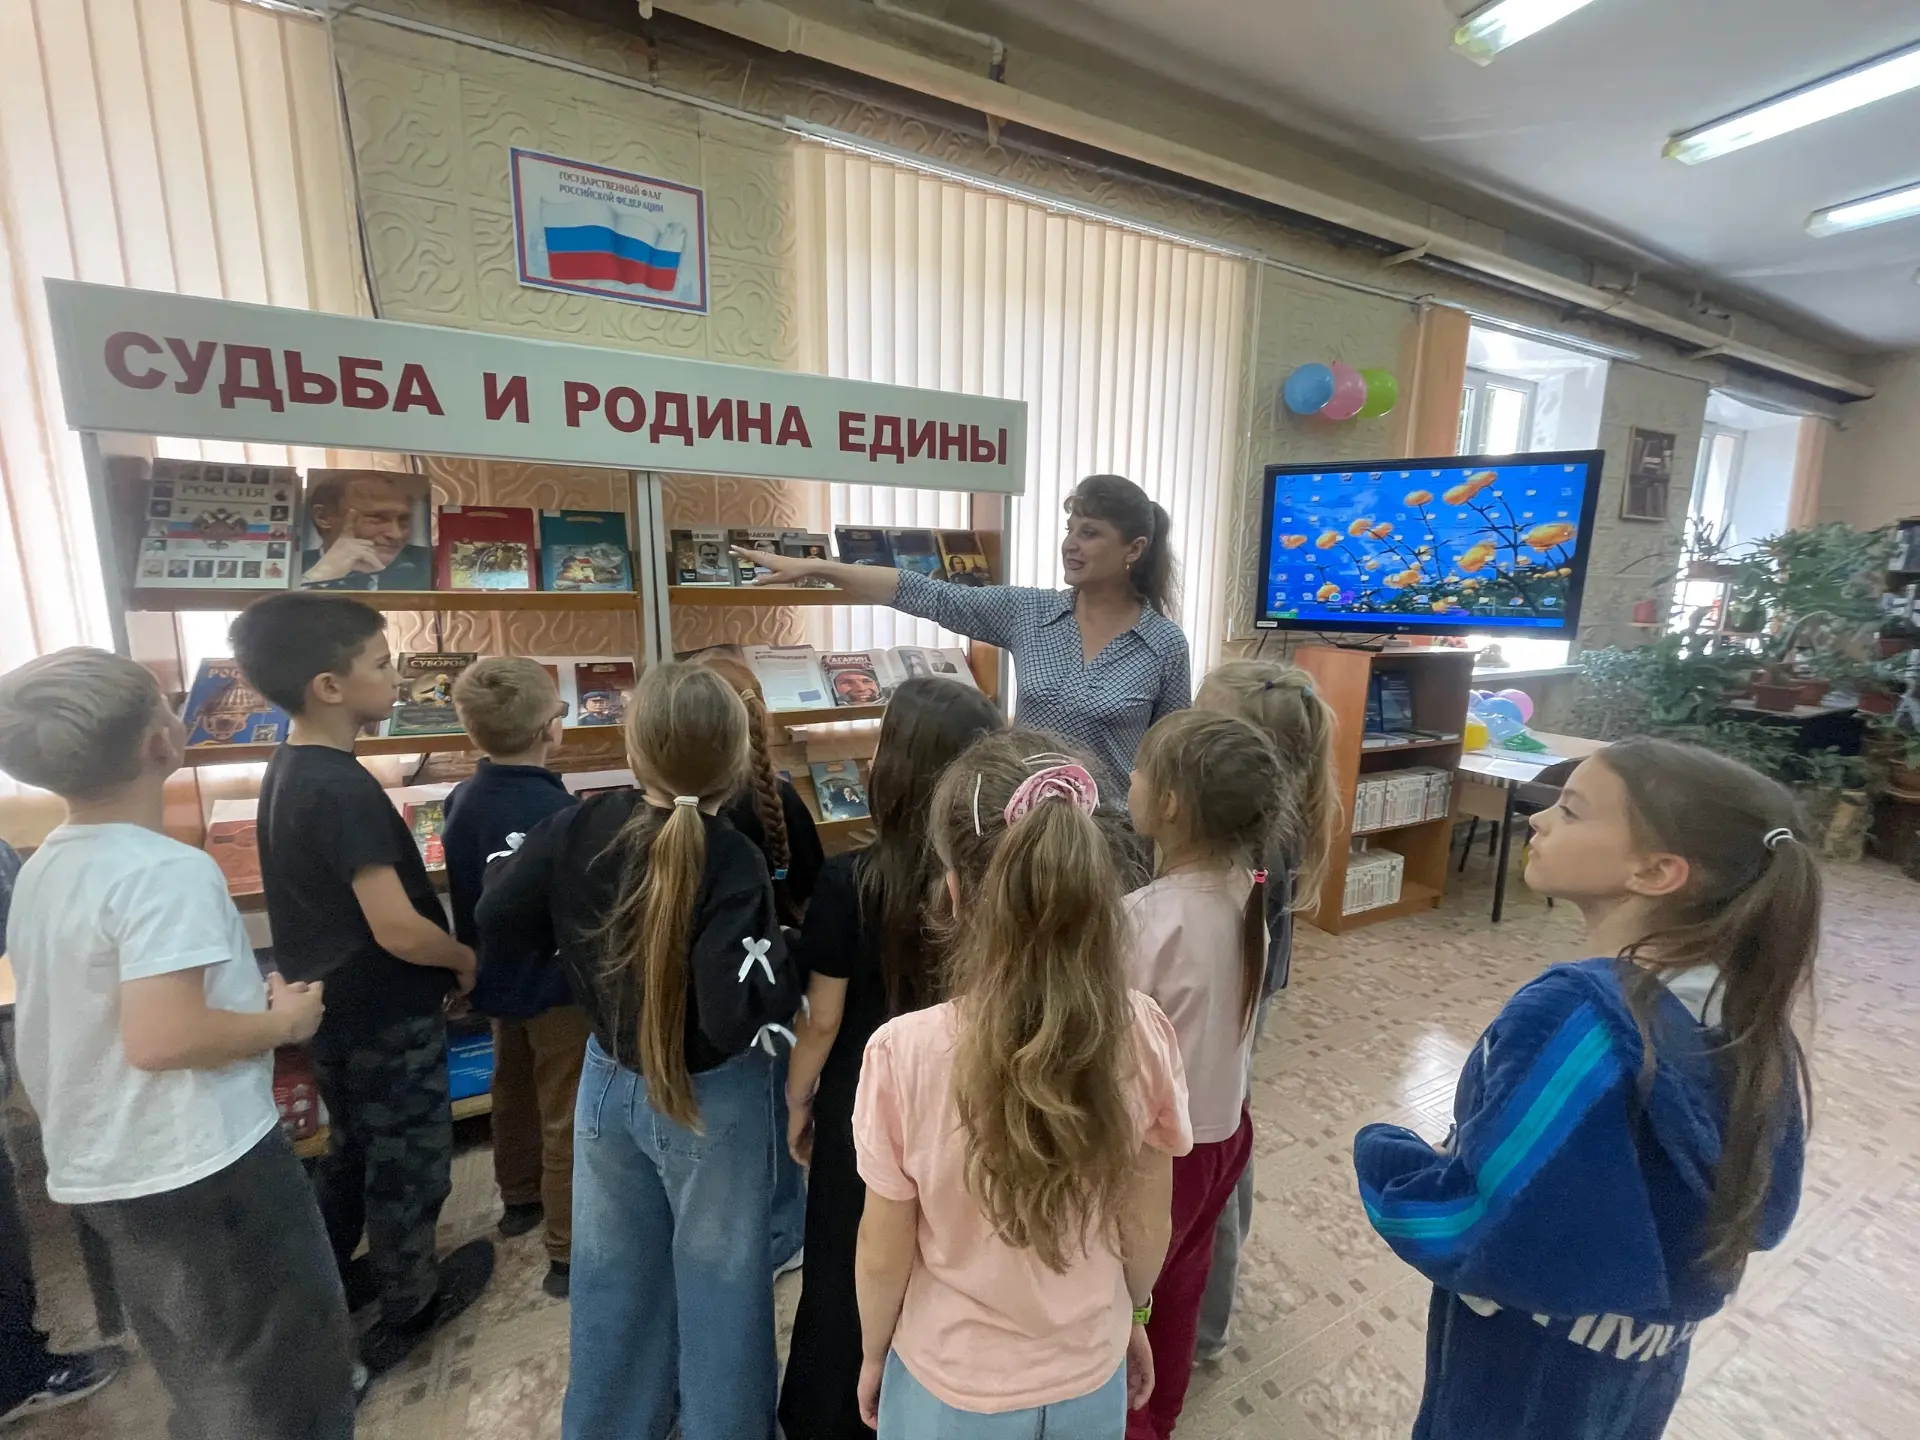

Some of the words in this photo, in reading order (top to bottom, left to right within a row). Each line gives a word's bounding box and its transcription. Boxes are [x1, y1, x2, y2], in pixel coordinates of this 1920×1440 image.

[559, 171, 640, 196] ГОСУДАРСТВЕННЫЙ
[641, 188, 663, 201] ФЛАГ
[559, 184, 615, 204] РОССИЙСКОЙ
[616, 196, 664, 213] ФЕДЕРАЦИИ
[103, 330, 443, 416] СУДЬБА
[484, 372, 530, 424] И
[564, 381, 812, 448] РОДИНА
[838, 410, 1008, 465] ЕДИНЫ
[181, 484, 266, 498] РОССИЯ
[410, 660, 467, 668] СУВОРОВ
[827, 655, 869, 665] ГАГАРИН
